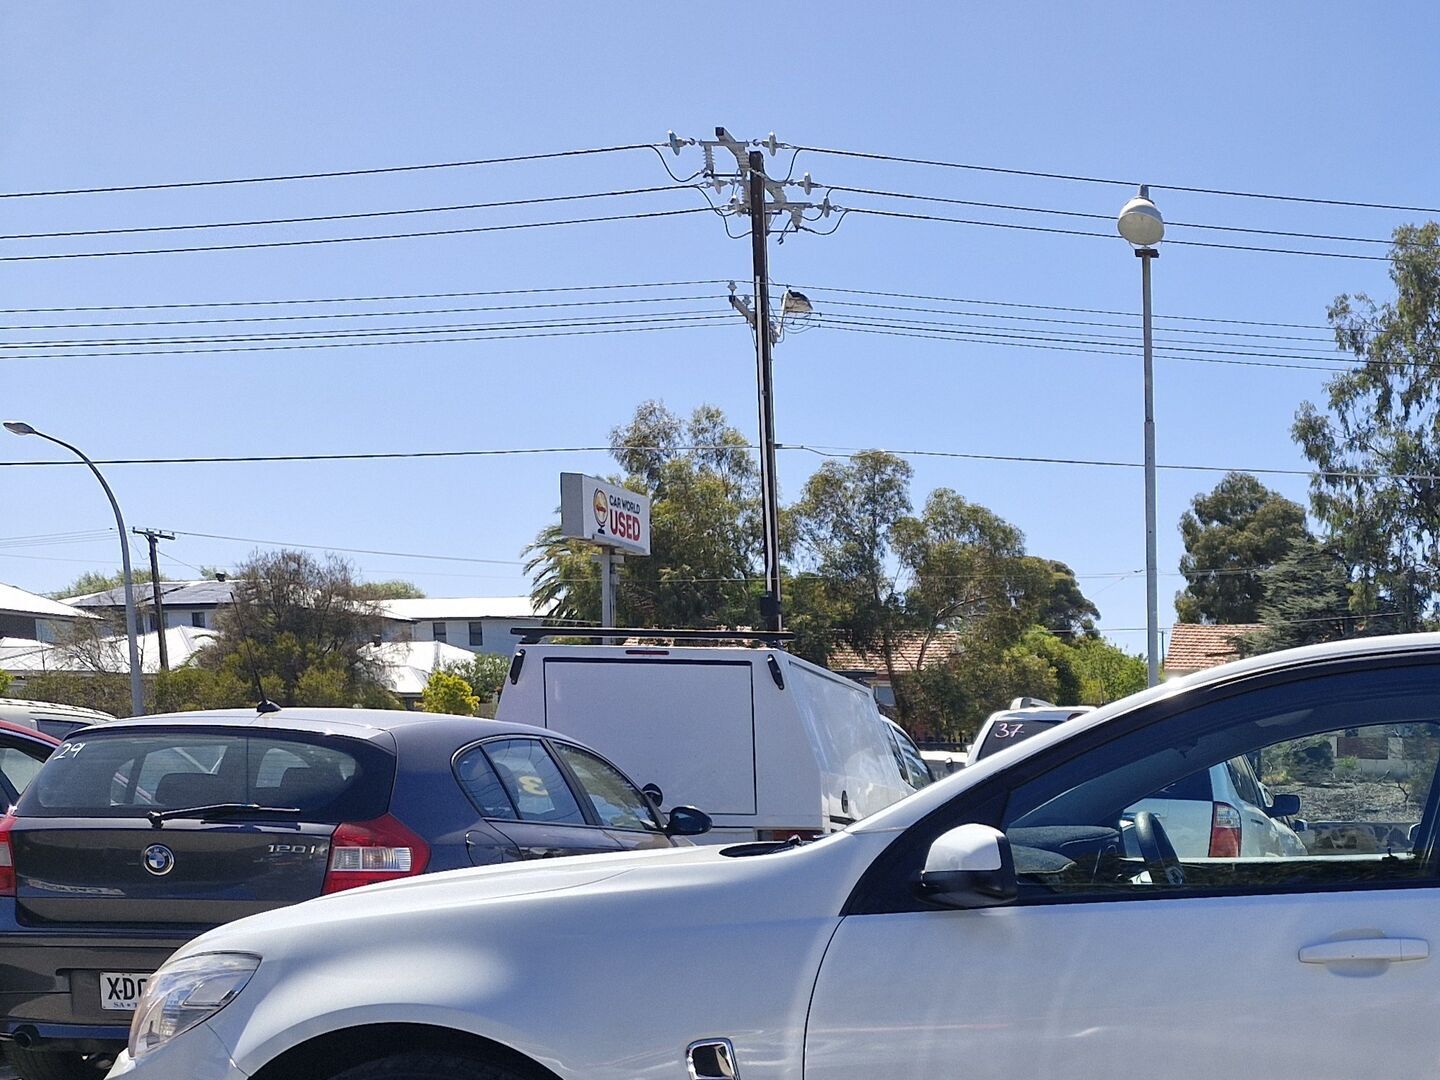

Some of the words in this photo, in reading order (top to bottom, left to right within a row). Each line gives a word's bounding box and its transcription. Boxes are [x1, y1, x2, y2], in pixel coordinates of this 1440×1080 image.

[609, 494, 621, 509] CAR
[622, 499, 641, 515] WORLD
[609, 509, 641, 541] USED
[995, 722, 1025, 738] 37
[53, 742, 87, 760] 29
